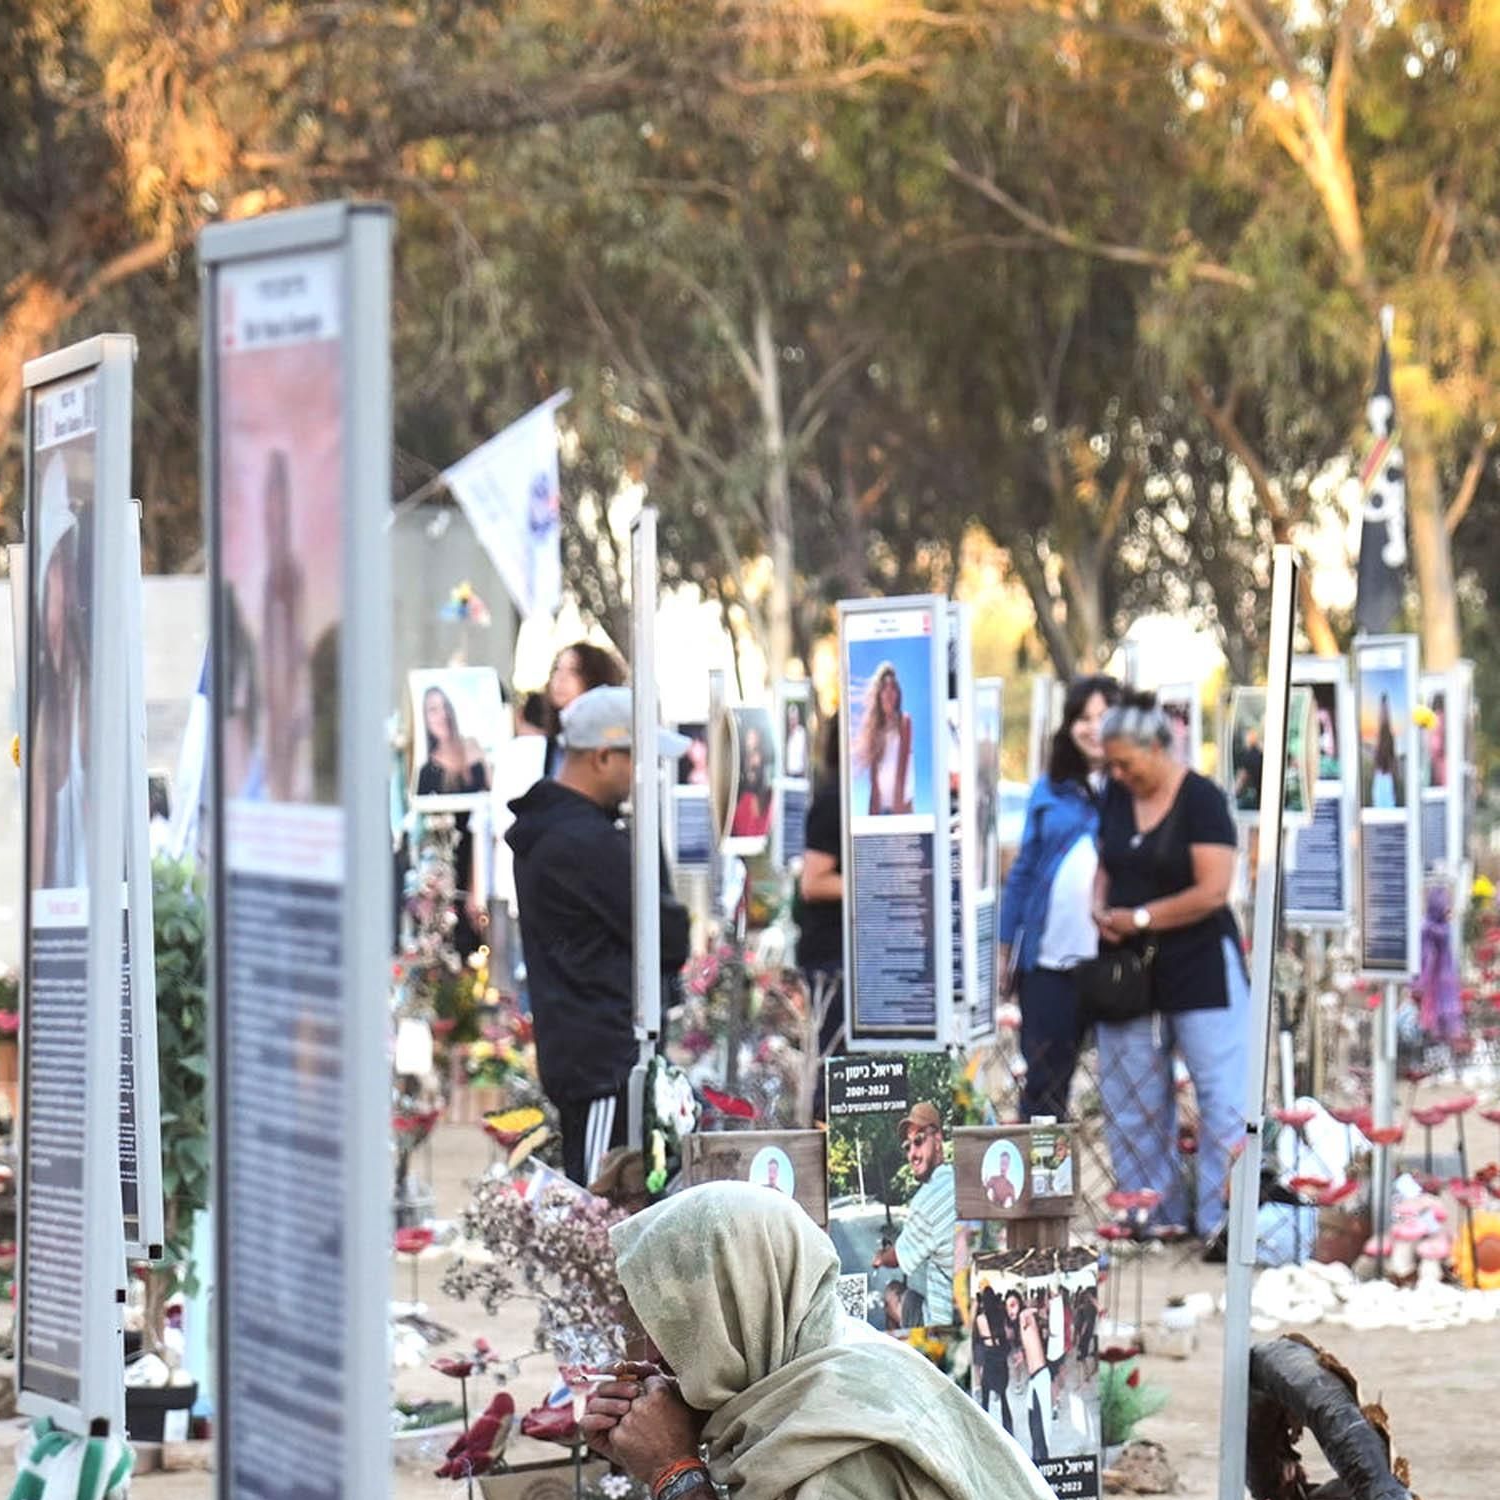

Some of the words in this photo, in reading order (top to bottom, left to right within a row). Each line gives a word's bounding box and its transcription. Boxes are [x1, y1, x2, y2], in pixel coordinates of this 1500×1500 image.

[871, 1061, 904, 1077] אריאל
[845, 1084, 889, 1098] 2001-2023
[1064, 1459, 1094, 1475] אריאל
